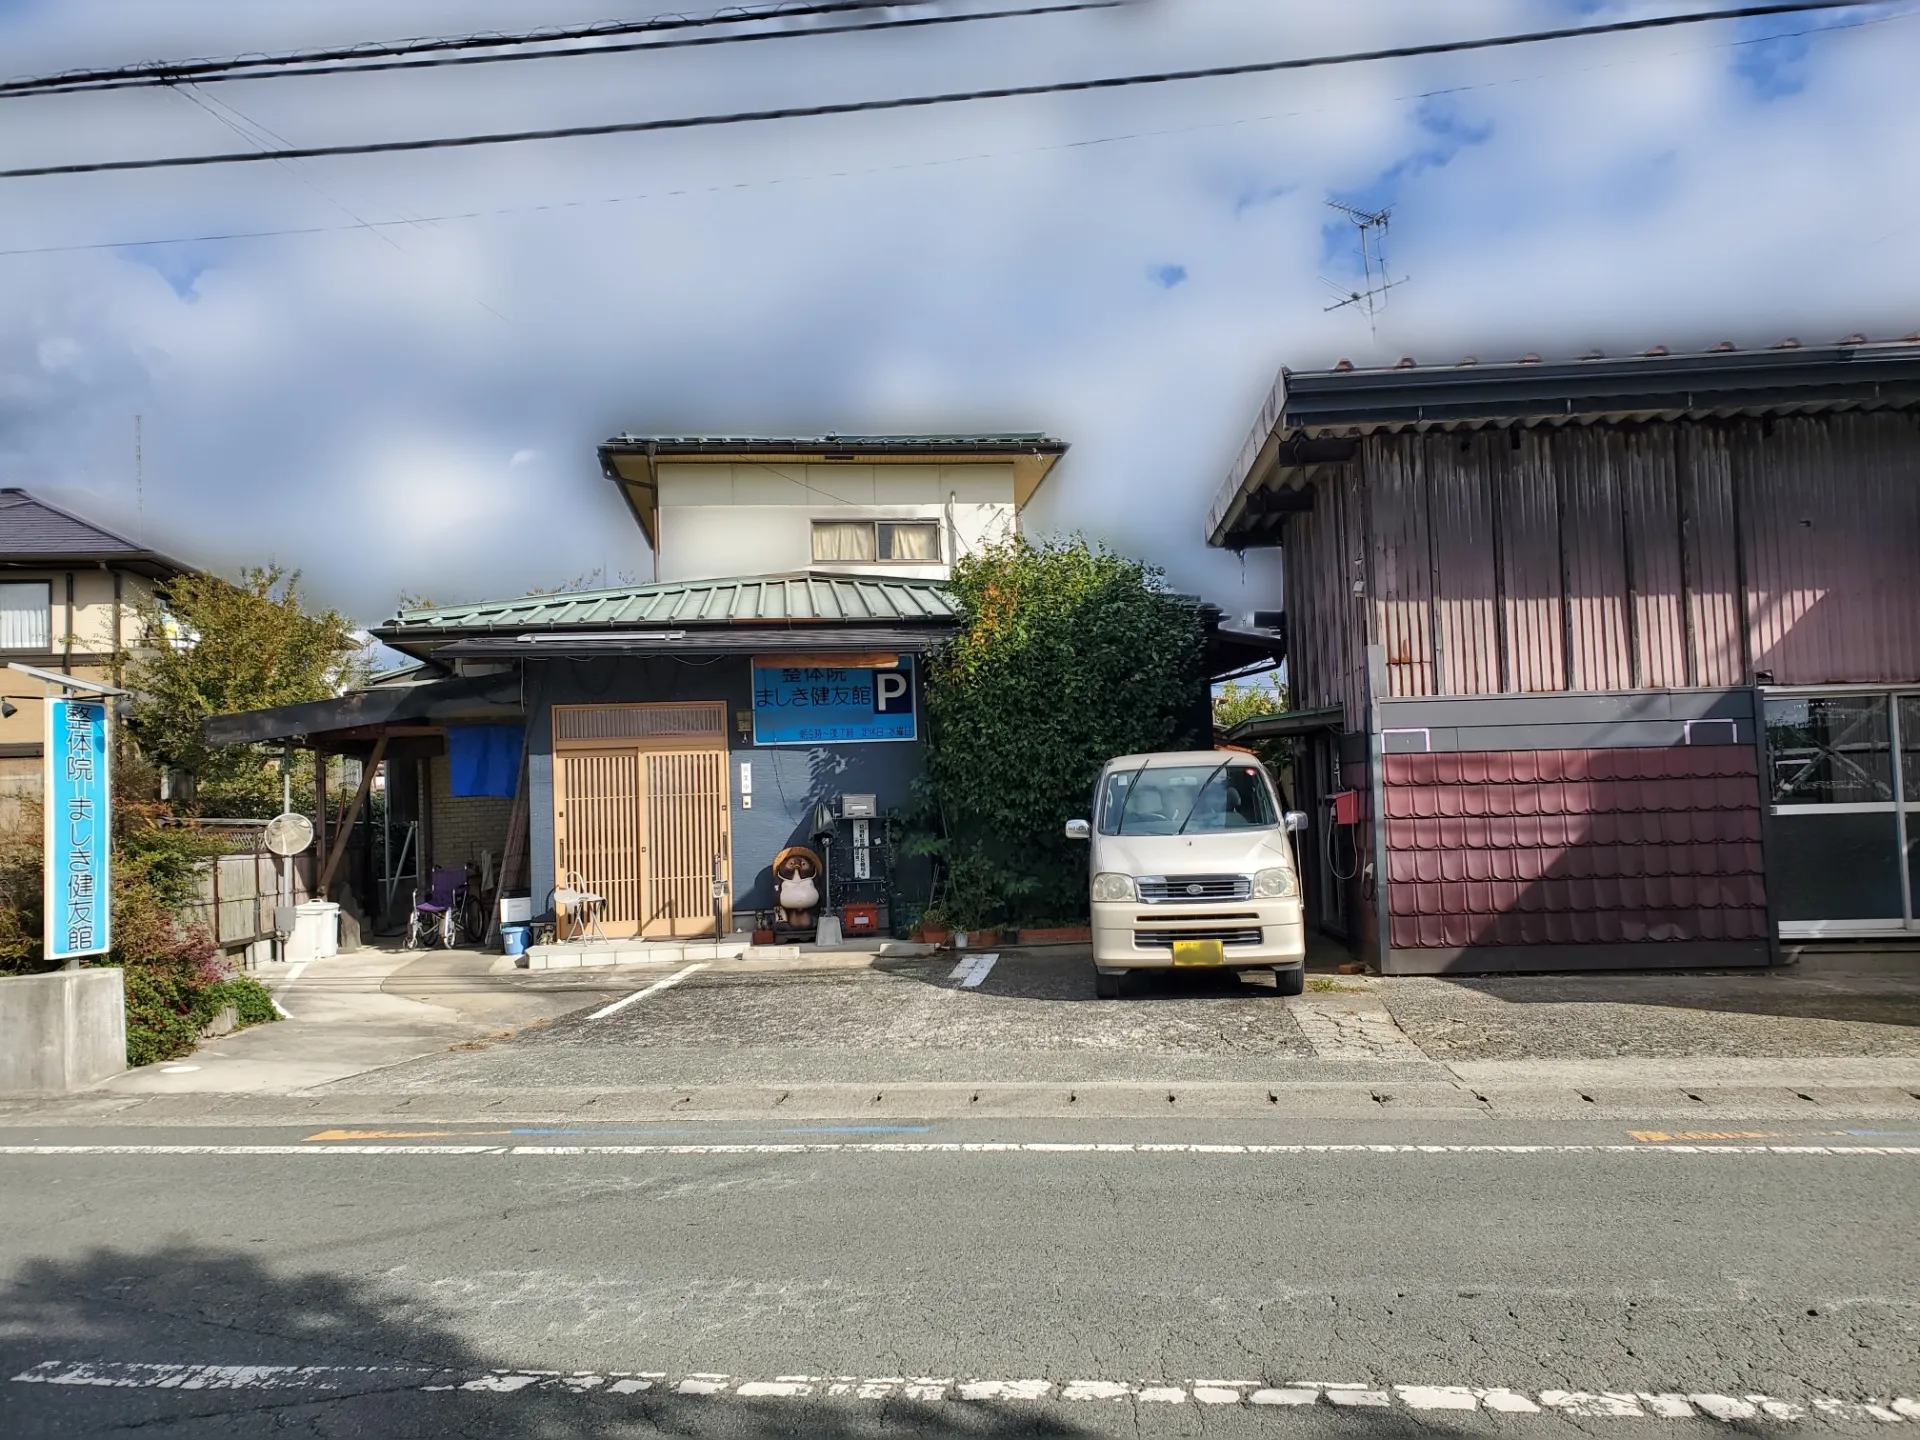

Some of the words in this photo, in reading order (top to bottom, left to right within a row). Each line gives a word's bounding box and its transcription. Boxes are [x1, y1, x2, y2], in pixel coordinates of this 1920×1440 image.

[782, 668, 847, 683] 整体院
[877, 673, 907, 711] P
[755, 686, 872, 707] ましき健友館
[66, 703, 93, 781] 整体院
[66, 796, 94, 951] ましき健友館
